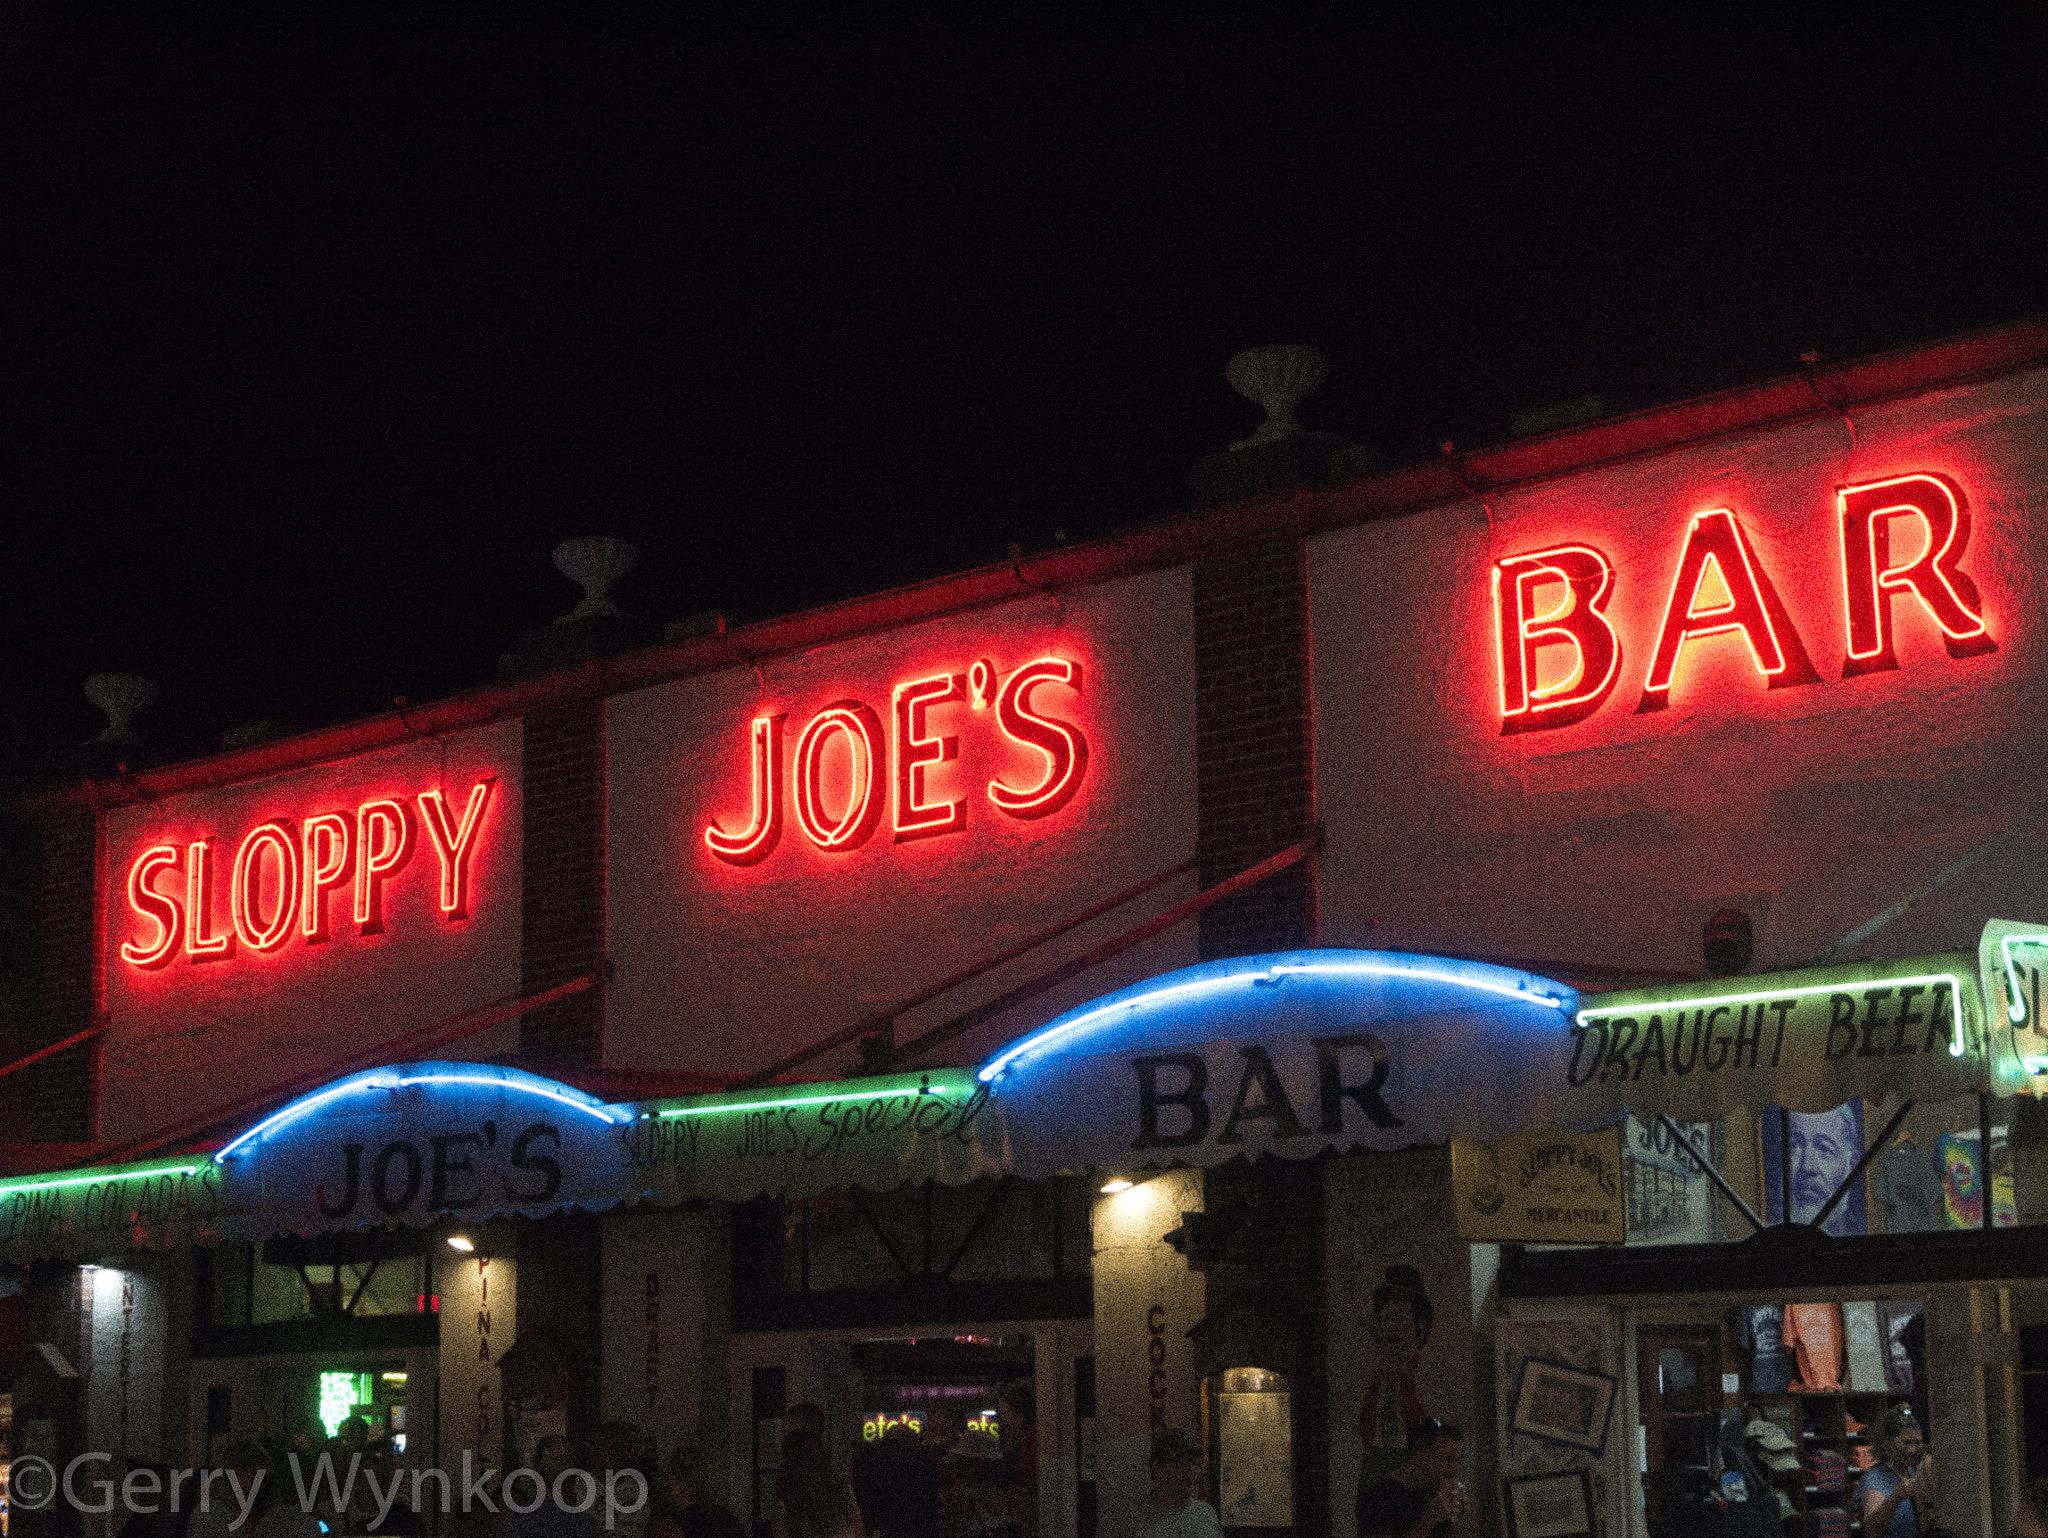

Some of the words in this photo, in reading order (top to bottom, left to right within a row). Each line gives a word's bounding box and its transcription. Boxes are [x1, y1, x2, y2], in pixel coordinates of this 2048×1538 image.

[121, 779, 496, 969] SLOPPY
[705, 658, 1089, 866] JOE'S
[1492, 471, 1998, 736] BAR
[1131, 1033, 1405, 1150] BAR
[1567, 1001, 1796, 1087] DRAUGHT
[316, 1119, 563, 1219] JOE'S
[621, 1119, 700, 1168] SLOPPY
[736, 1105, 798, 1158] JOE'S
